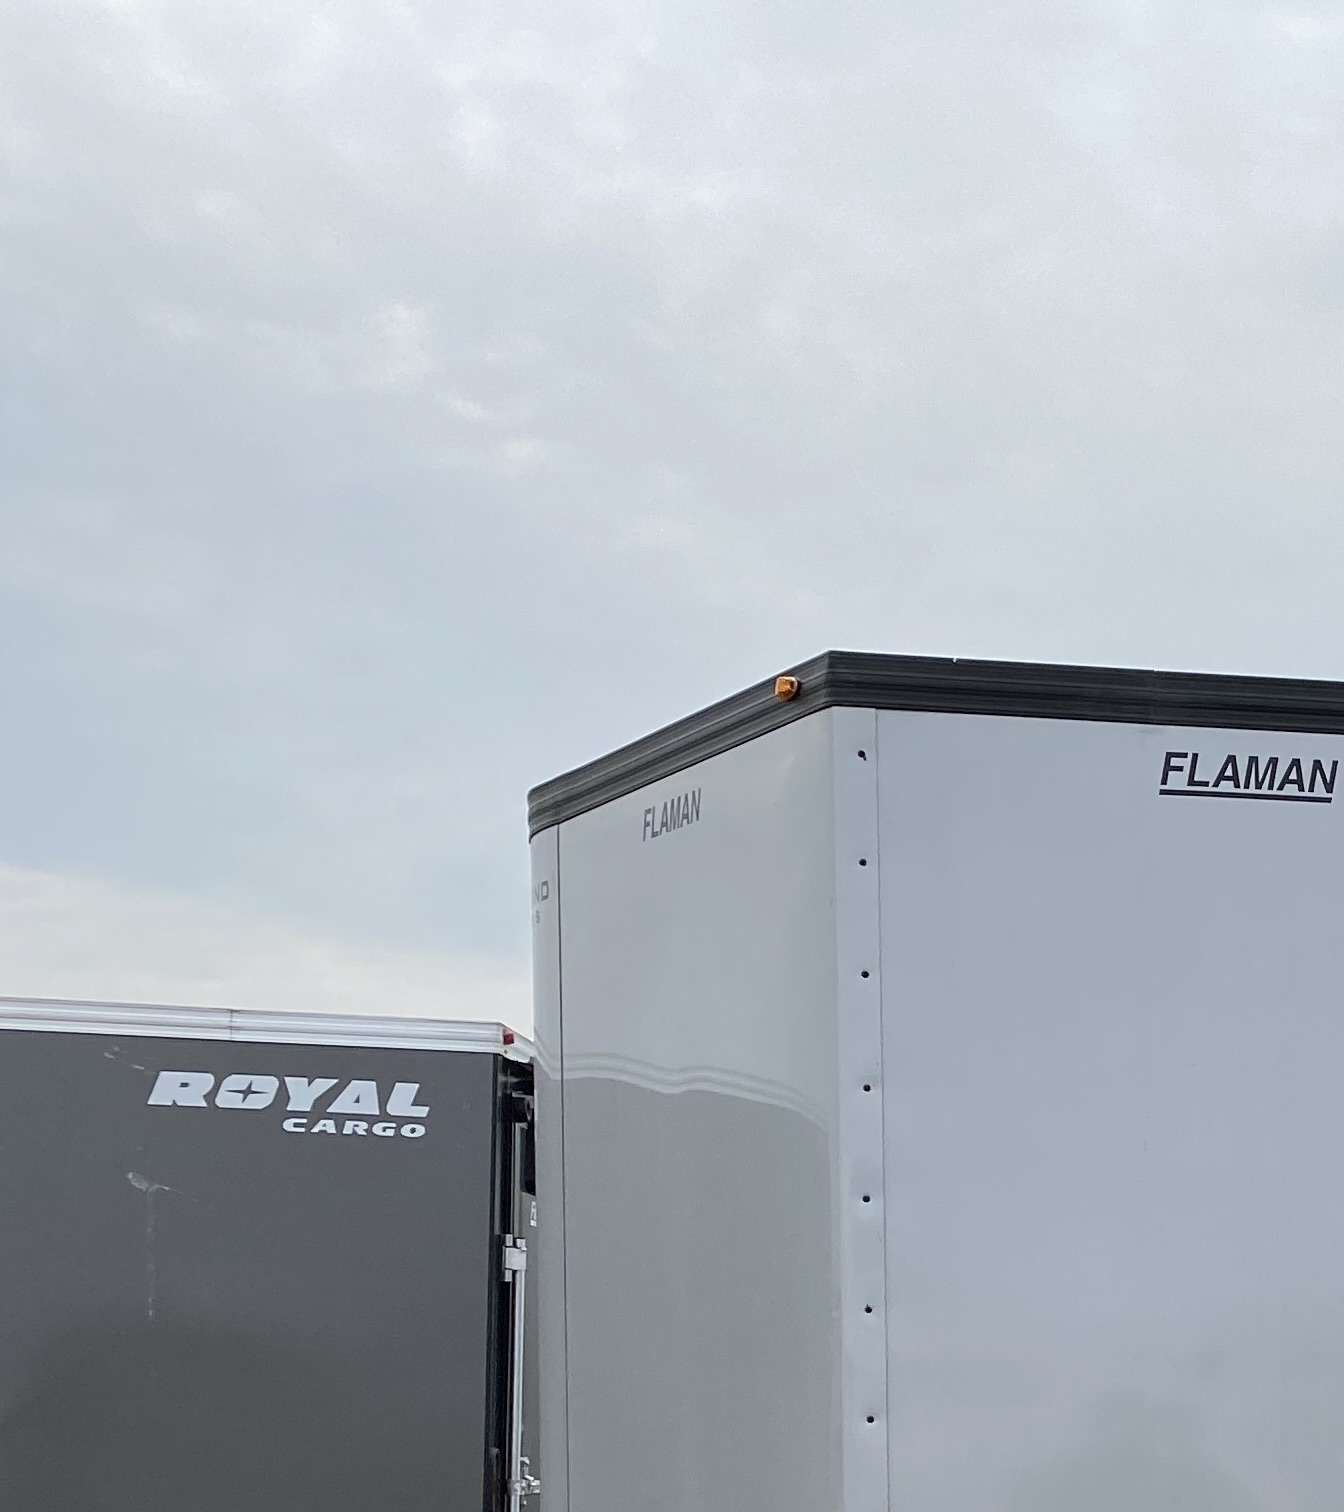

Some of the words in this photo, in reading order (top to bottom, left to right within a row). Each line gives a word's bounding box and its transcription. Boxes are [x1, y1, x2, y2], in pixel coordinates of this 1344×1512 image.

[1159, 751, 1339, 794] FLAMAN
[642, 787, 702, 842] FLAMAN
[147, 1071, 430, 1118] ROYAL
[282, 1117, 427, 1139] CARGO
